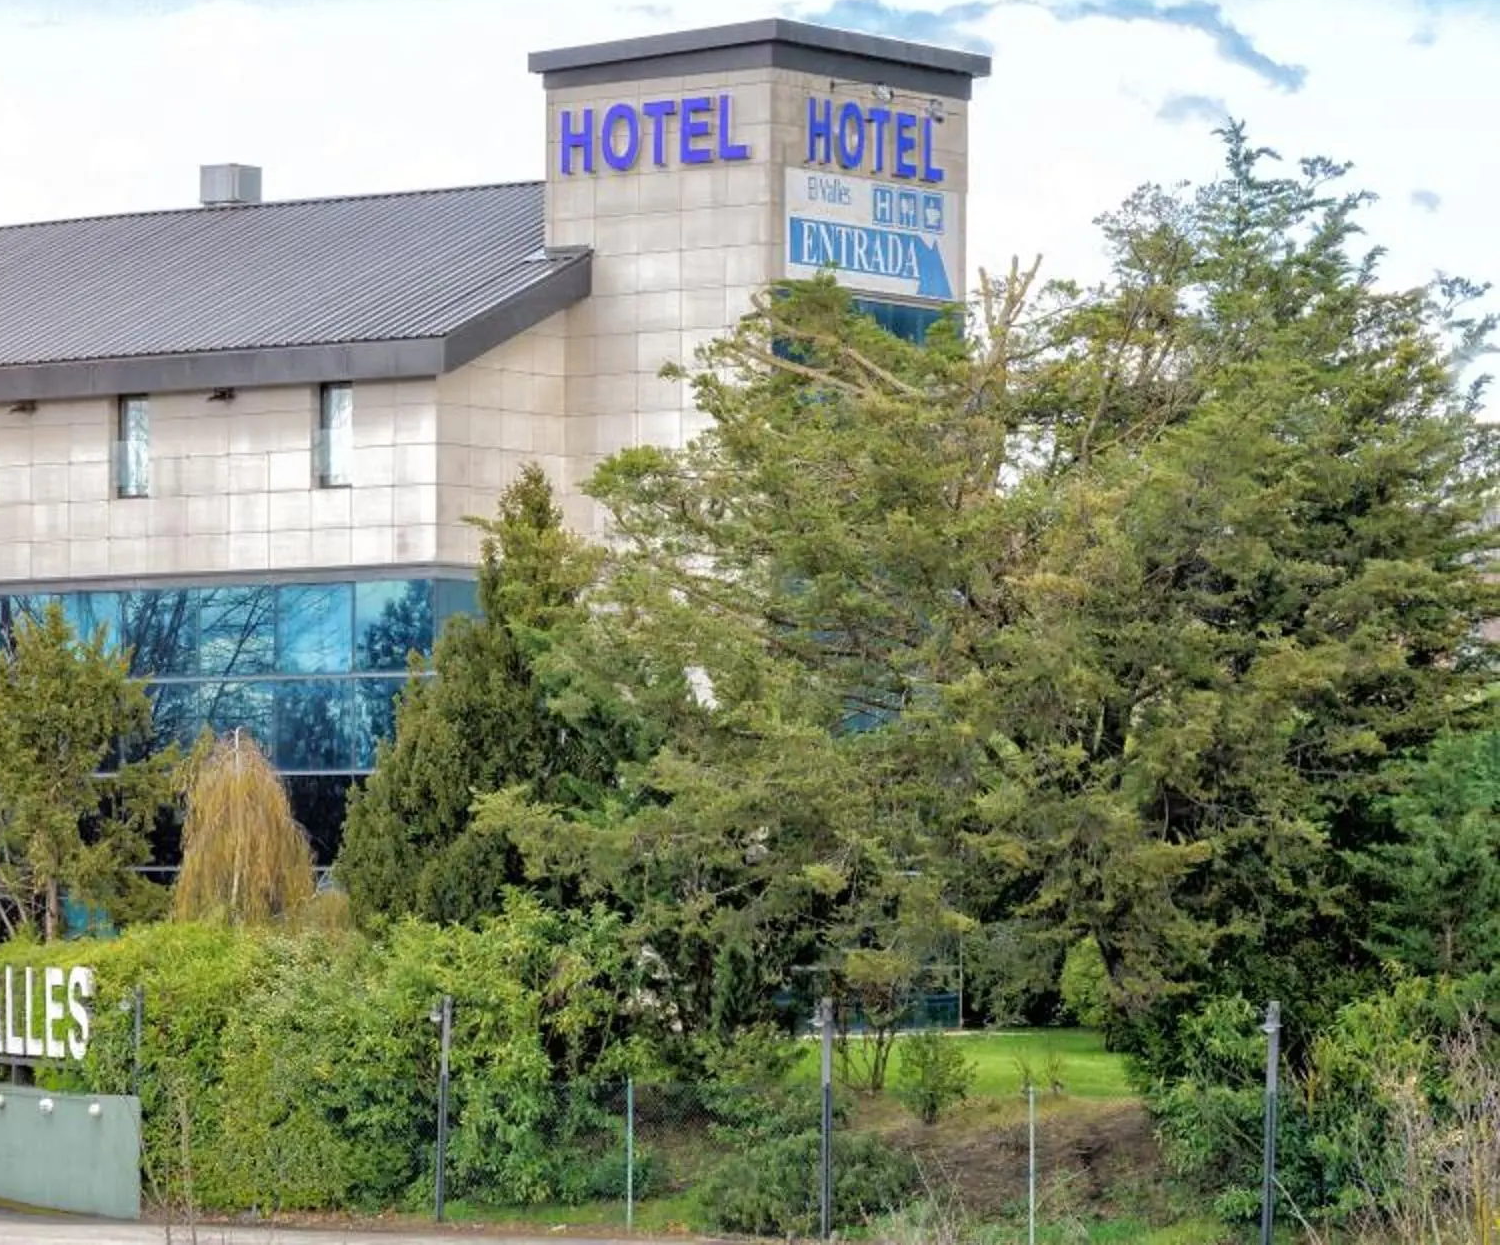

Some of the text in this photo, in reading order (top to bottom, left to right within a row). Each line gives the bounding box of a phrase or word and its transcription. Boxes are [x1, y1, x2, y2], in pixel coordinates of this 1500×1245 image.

[561, 95, 749, 175] HOTEL
[806, 97, 944, 183] HOTEL
[802, 221, 920, 278] ENTRADA
